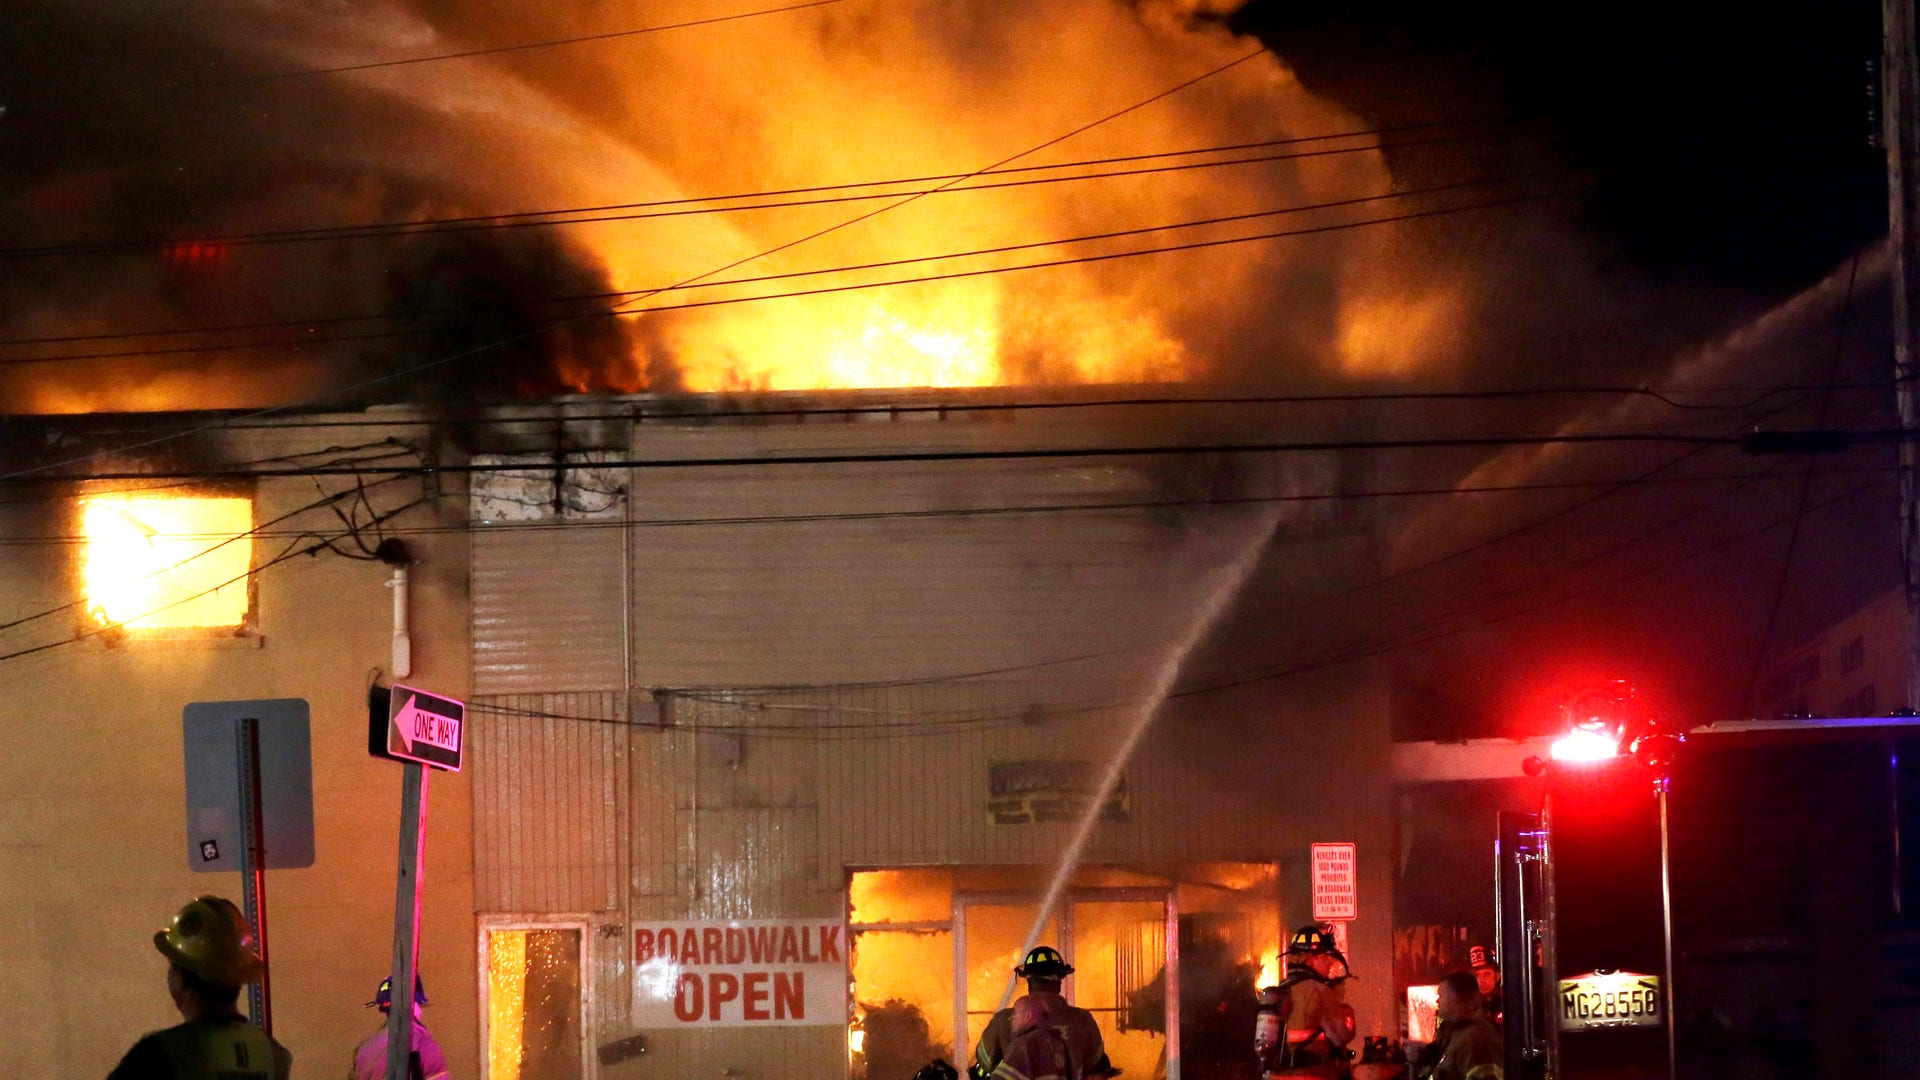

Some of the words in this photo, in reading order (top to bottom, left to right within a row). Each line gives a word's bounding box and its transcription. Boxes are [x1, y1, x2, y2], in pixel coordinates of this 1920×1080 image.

[414, 712, 435, 742] ONE
[437, 718, 456, 747] WAY
[1338, 851, 1351, 861] OVER
[1321, 873, 1347, 883] PROHIBITED
[1317, 884, 1324, 894] ON
[1325, 884, 1351, 894] BOARDWALK
[1316, 895, 1333, 905] UNLESS
[634, 924, 841, 966] BOARDWALK
[1470, 951, 1485, 963] 23
[673, 971, 806, 1022] OPEN
[1562, 988, 1657, 1019] MG28558
